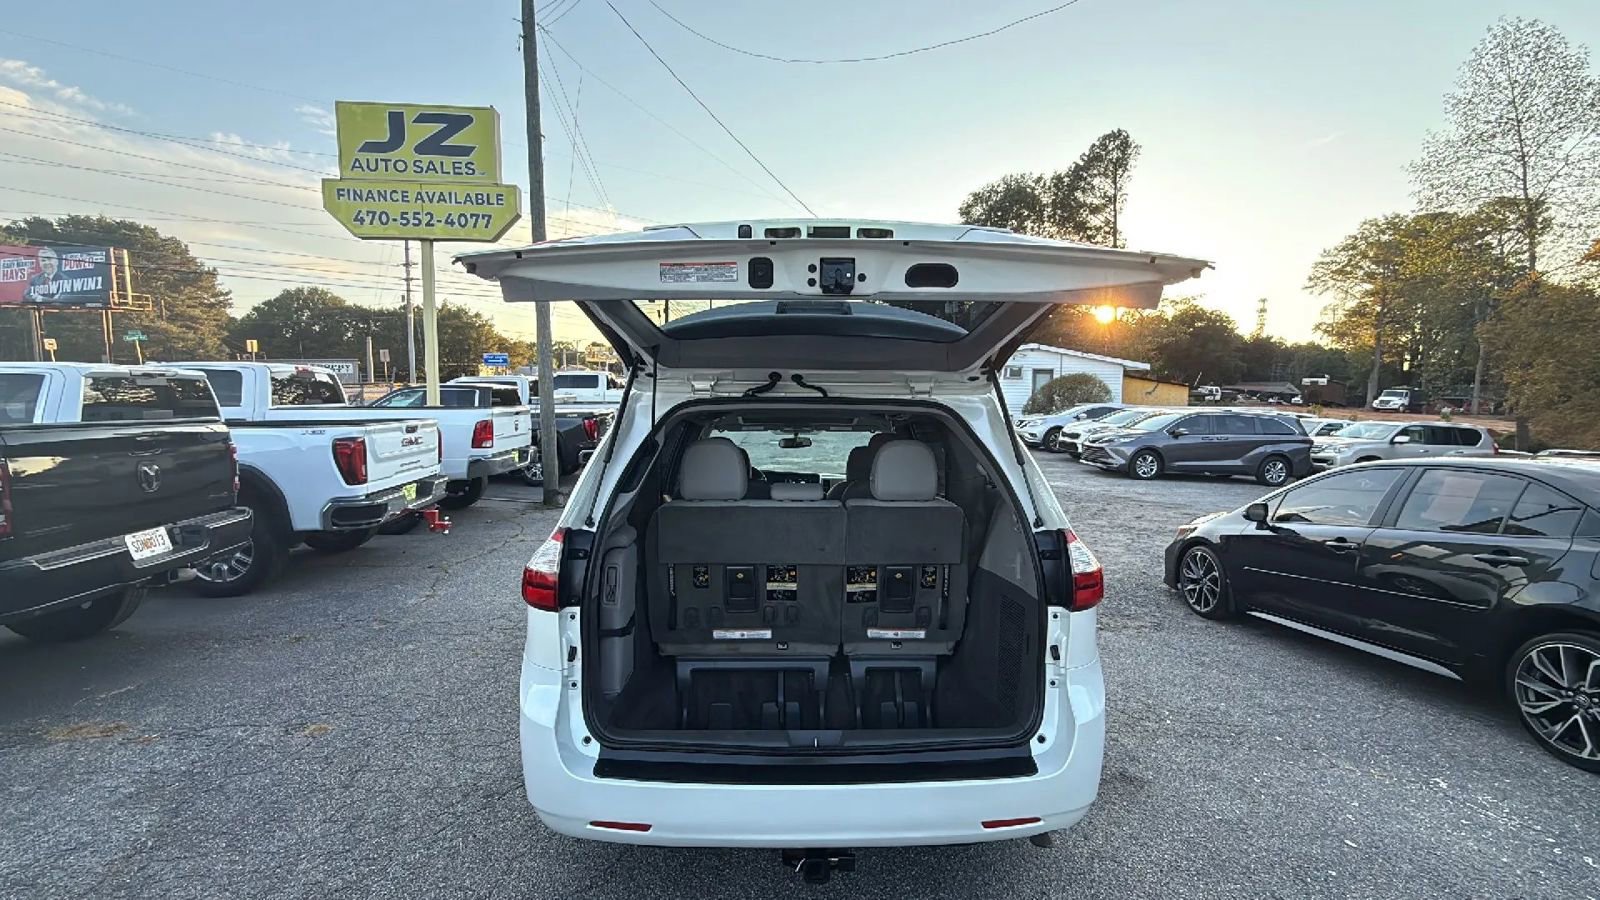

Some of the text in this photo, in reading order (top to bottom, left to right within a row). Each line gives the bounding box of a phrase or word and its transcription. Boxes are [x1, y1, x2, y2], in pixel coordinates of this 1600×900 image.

[357, 111, 477, 157] JZ
[351, 158, 476, 176] AUTO SALES
[336, 188, 504, 206] FINANCE AVAILABLE
[353, 210, 492, 229] 470-552-4077
[2, 267, 26, 281] HAYS
[401, 436, 424, 447] GMC
